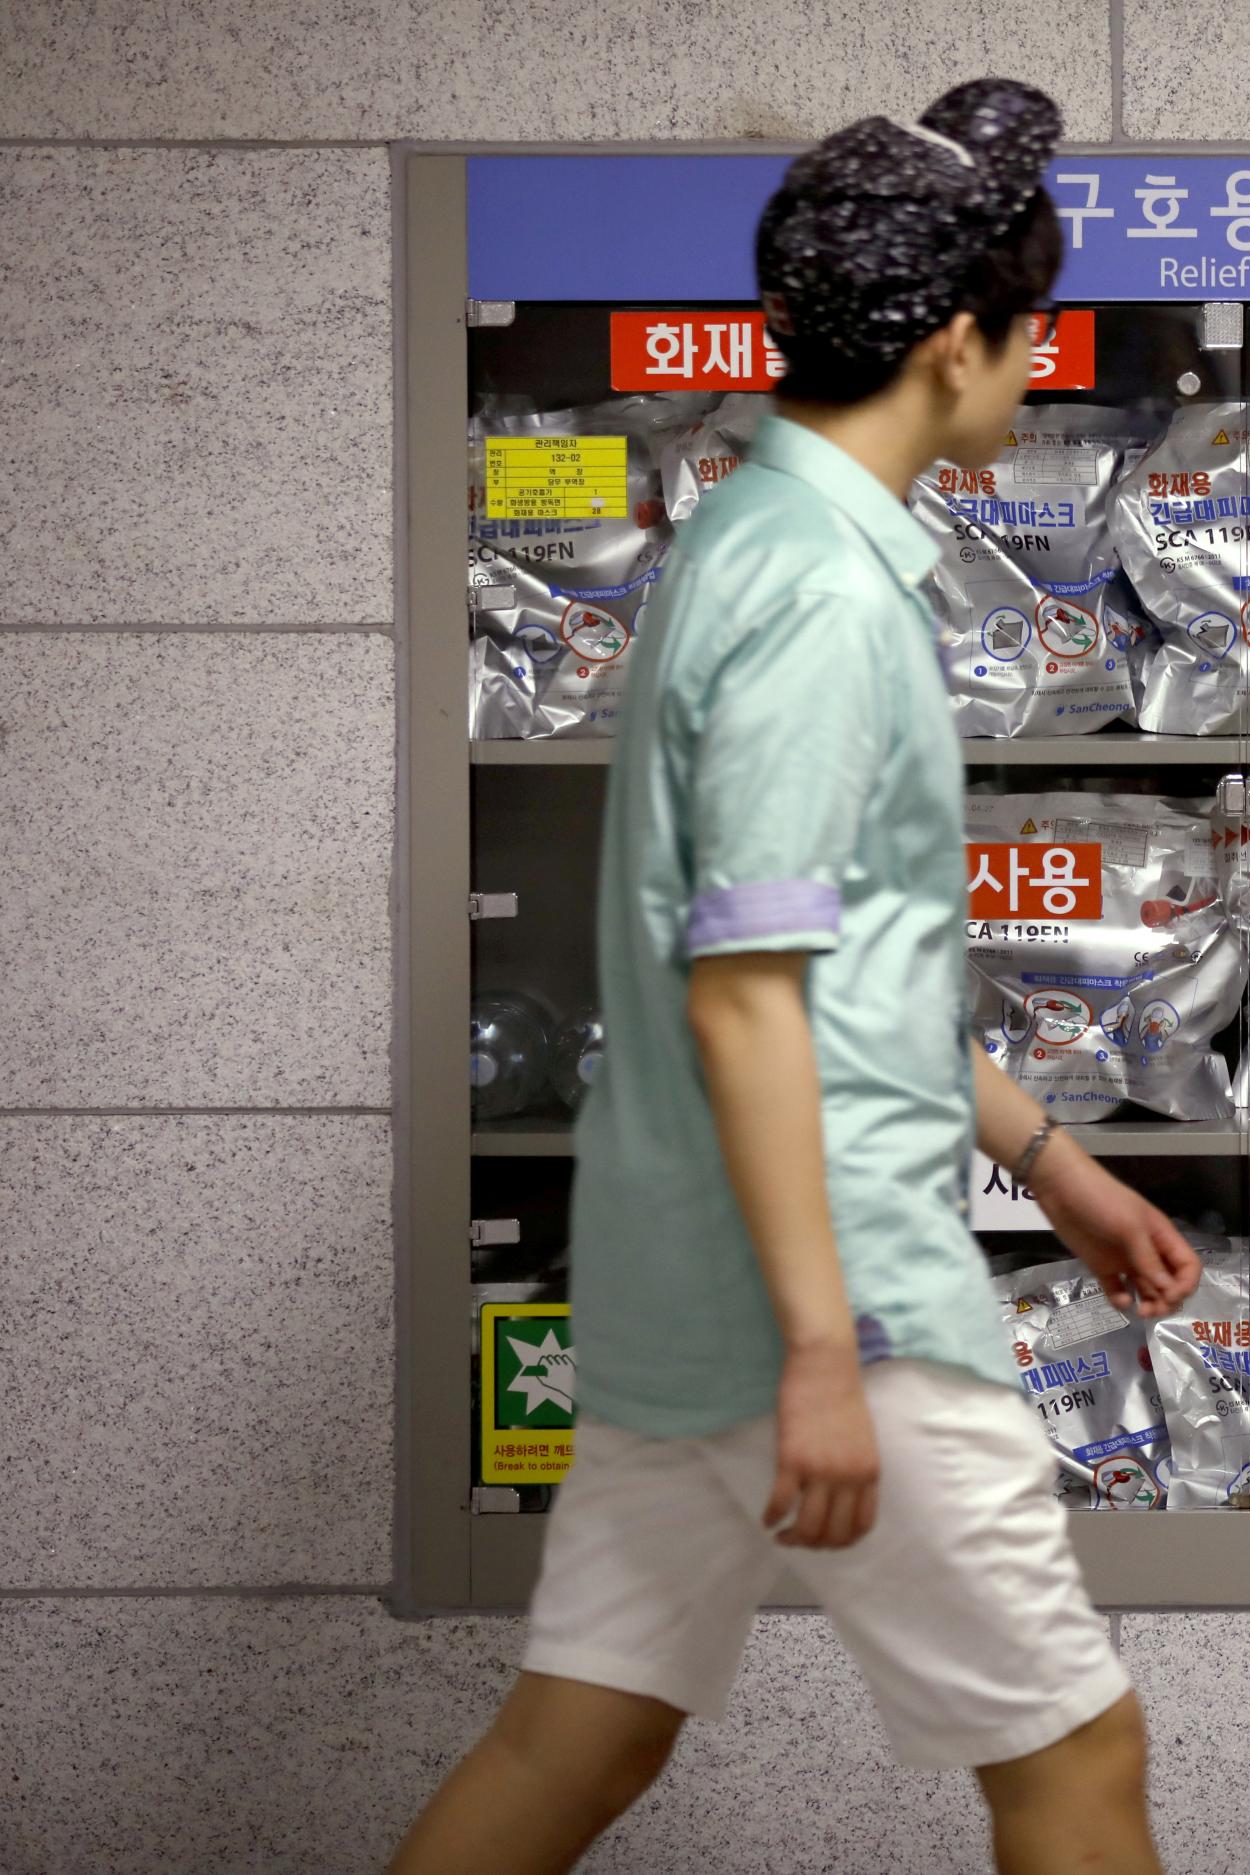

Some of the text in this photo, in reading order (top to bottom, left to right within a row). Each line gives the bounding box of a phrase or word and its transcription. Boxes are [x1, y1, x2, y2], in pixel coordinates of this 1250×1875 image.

[535, 439, 577, 448] 관리책임자
[1021, 432, 1037, 443] 주의
[551, 454, 581, 462] 132-02
[938, 468, 997, 495] 화재용
[1148, 471, 1211, 498] 화재용
[1156, 530, 1198, 551] SCA
[1069, 702, 1130, 714] SanCheong
[966, 847, 1089, 914] 사용
[1062, 1091, 1123, 1105] SanCheon
[1037, 1389, 1095, 1420] 119FN
[494, 1444, 549, 1457] 사용하려면
[494, 1461, 569, 1471] (Break to obtain
